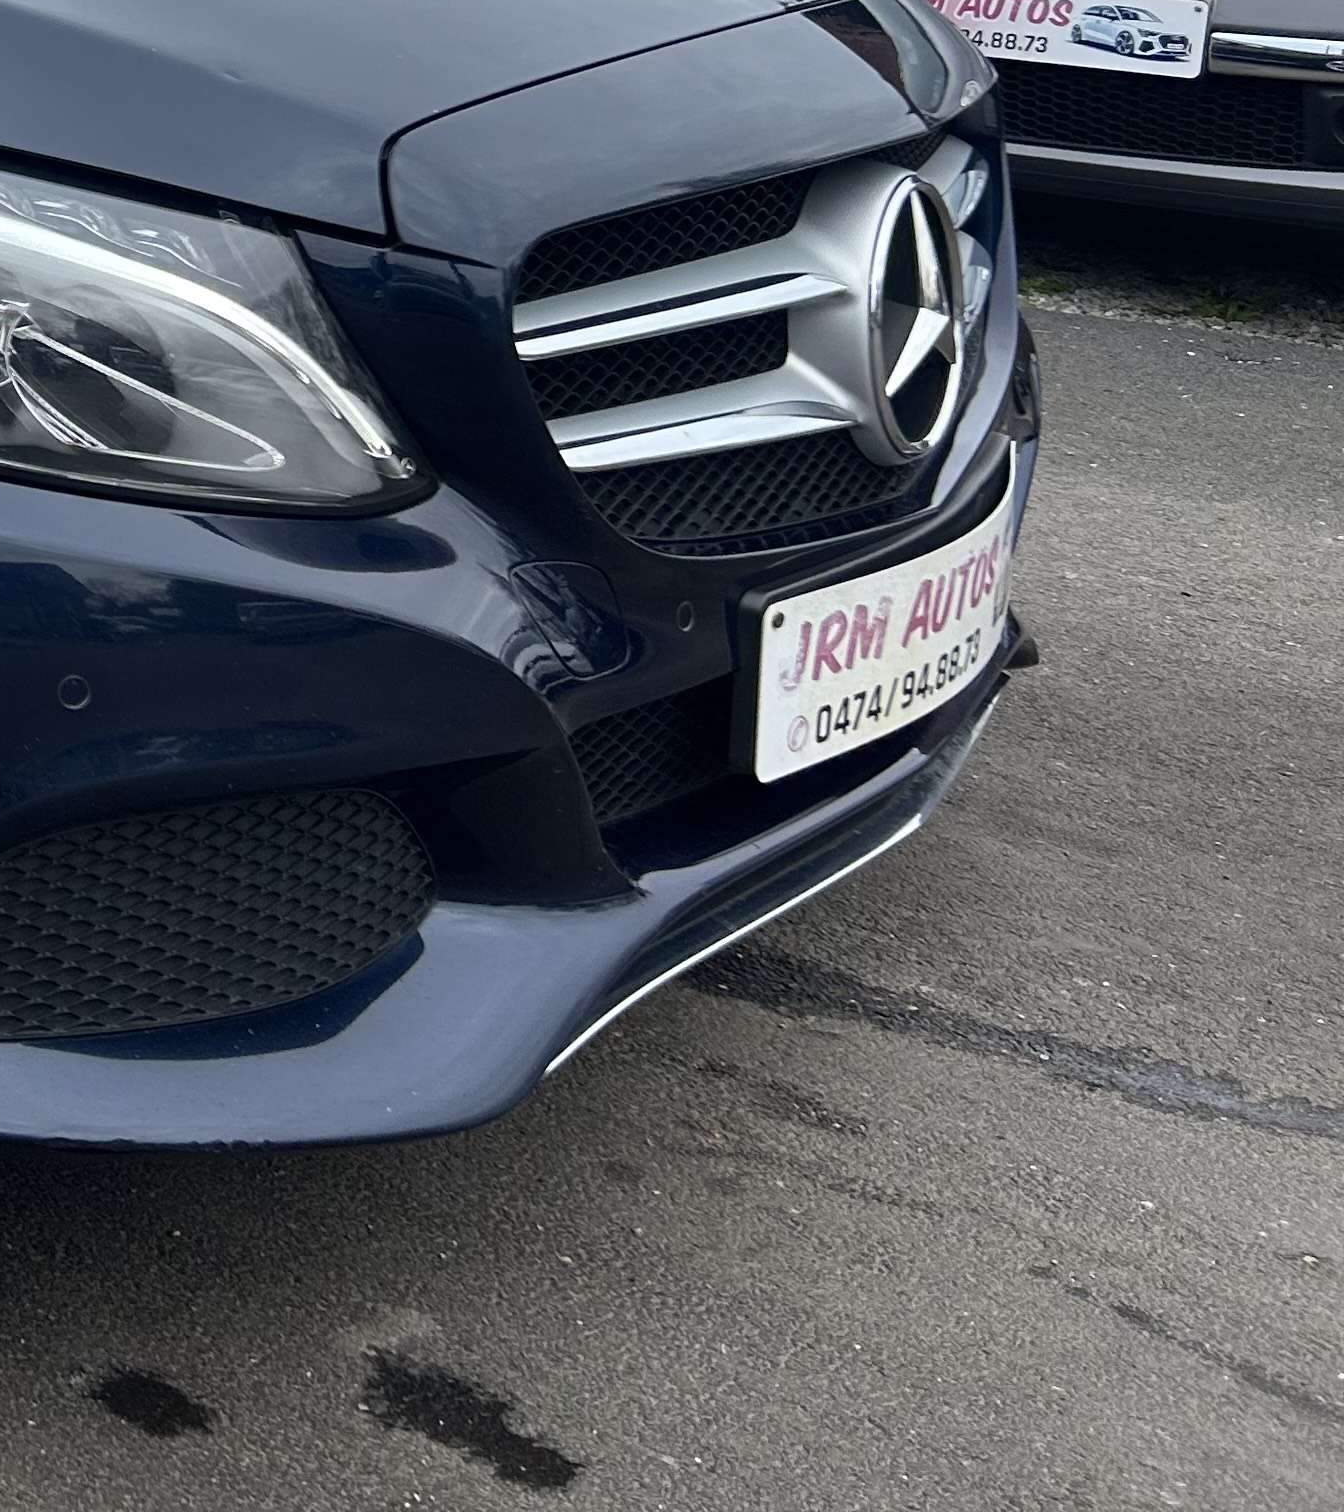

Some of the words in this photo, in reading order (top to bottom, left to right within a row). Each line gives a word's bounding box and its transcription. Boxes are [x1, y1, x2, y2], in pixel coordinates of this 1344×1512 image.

[779, 596, 894, 691] JRM
[901, 534, 1000, 648] AUTOS
[815, 628, 982, 743] 0474/94.88.73
